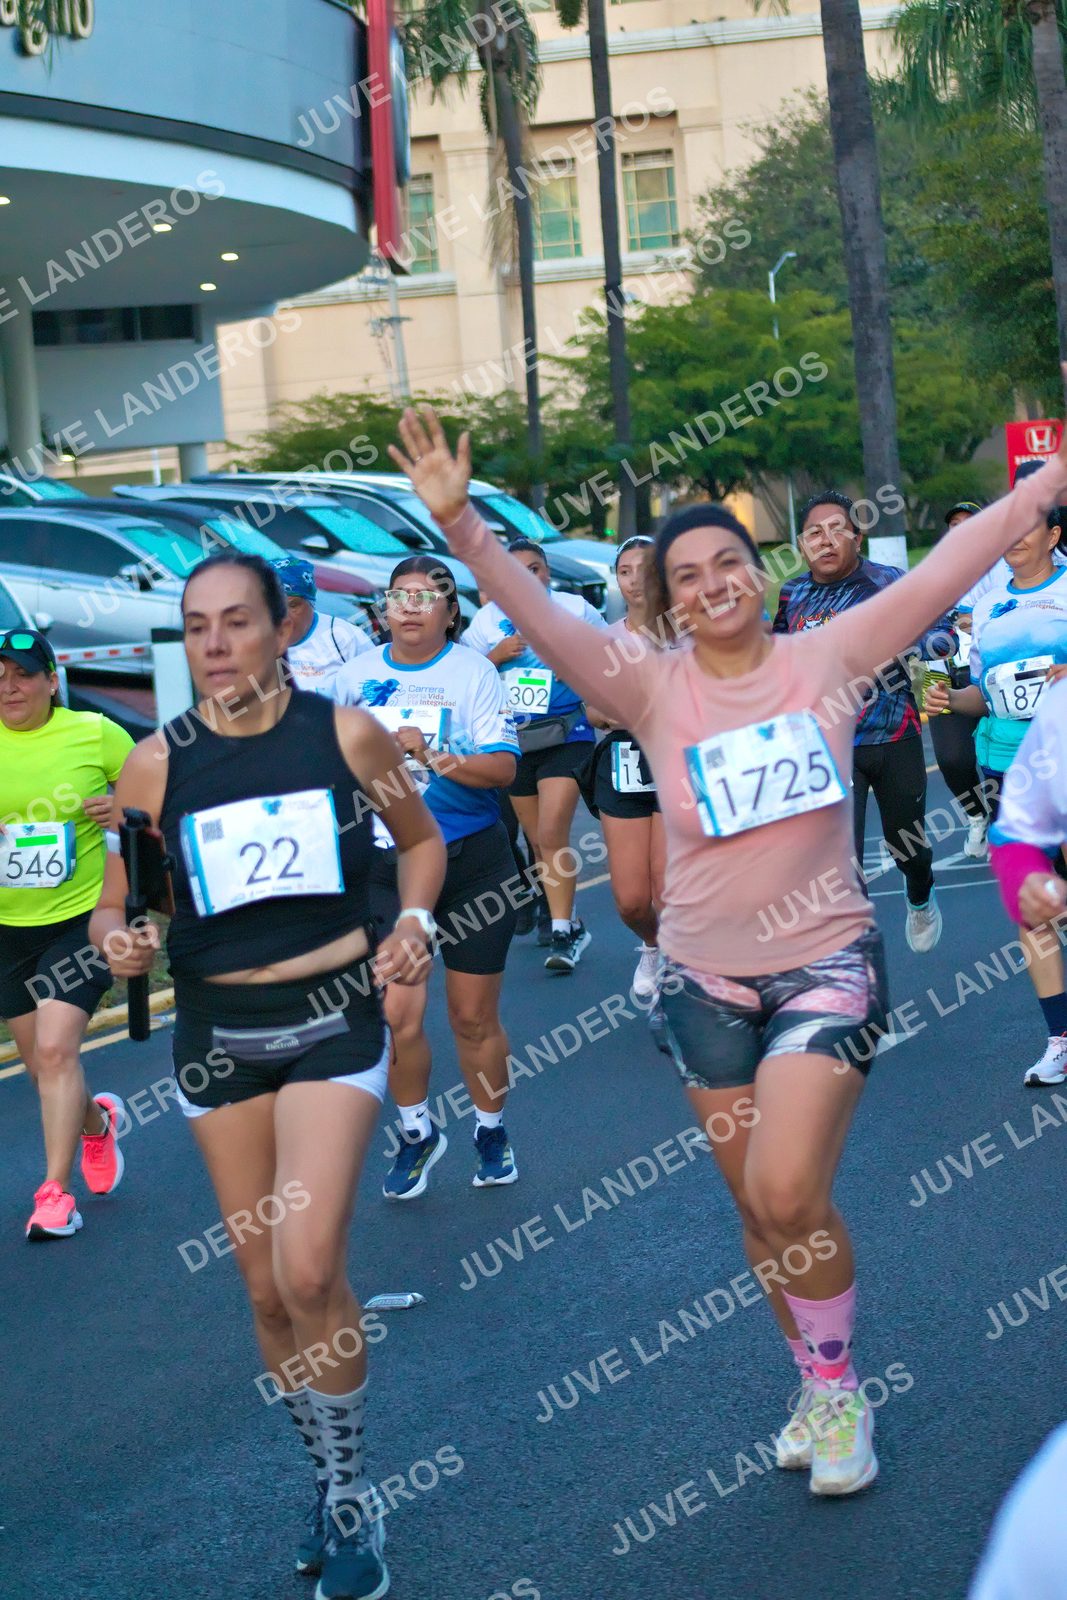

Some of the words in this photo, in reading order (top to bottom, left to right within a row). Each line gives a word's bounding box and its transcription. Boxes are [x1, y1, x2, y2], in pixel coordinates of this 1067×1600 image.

[408, 684, 445, 693] Carrera
[509, 686, 549, 707] 302
[999, 681, 1045, 713] 187
[715, 750, 831, 817] 1725
[6, 849, 64, 879] 546
[239, 836, 304, 886] 22
